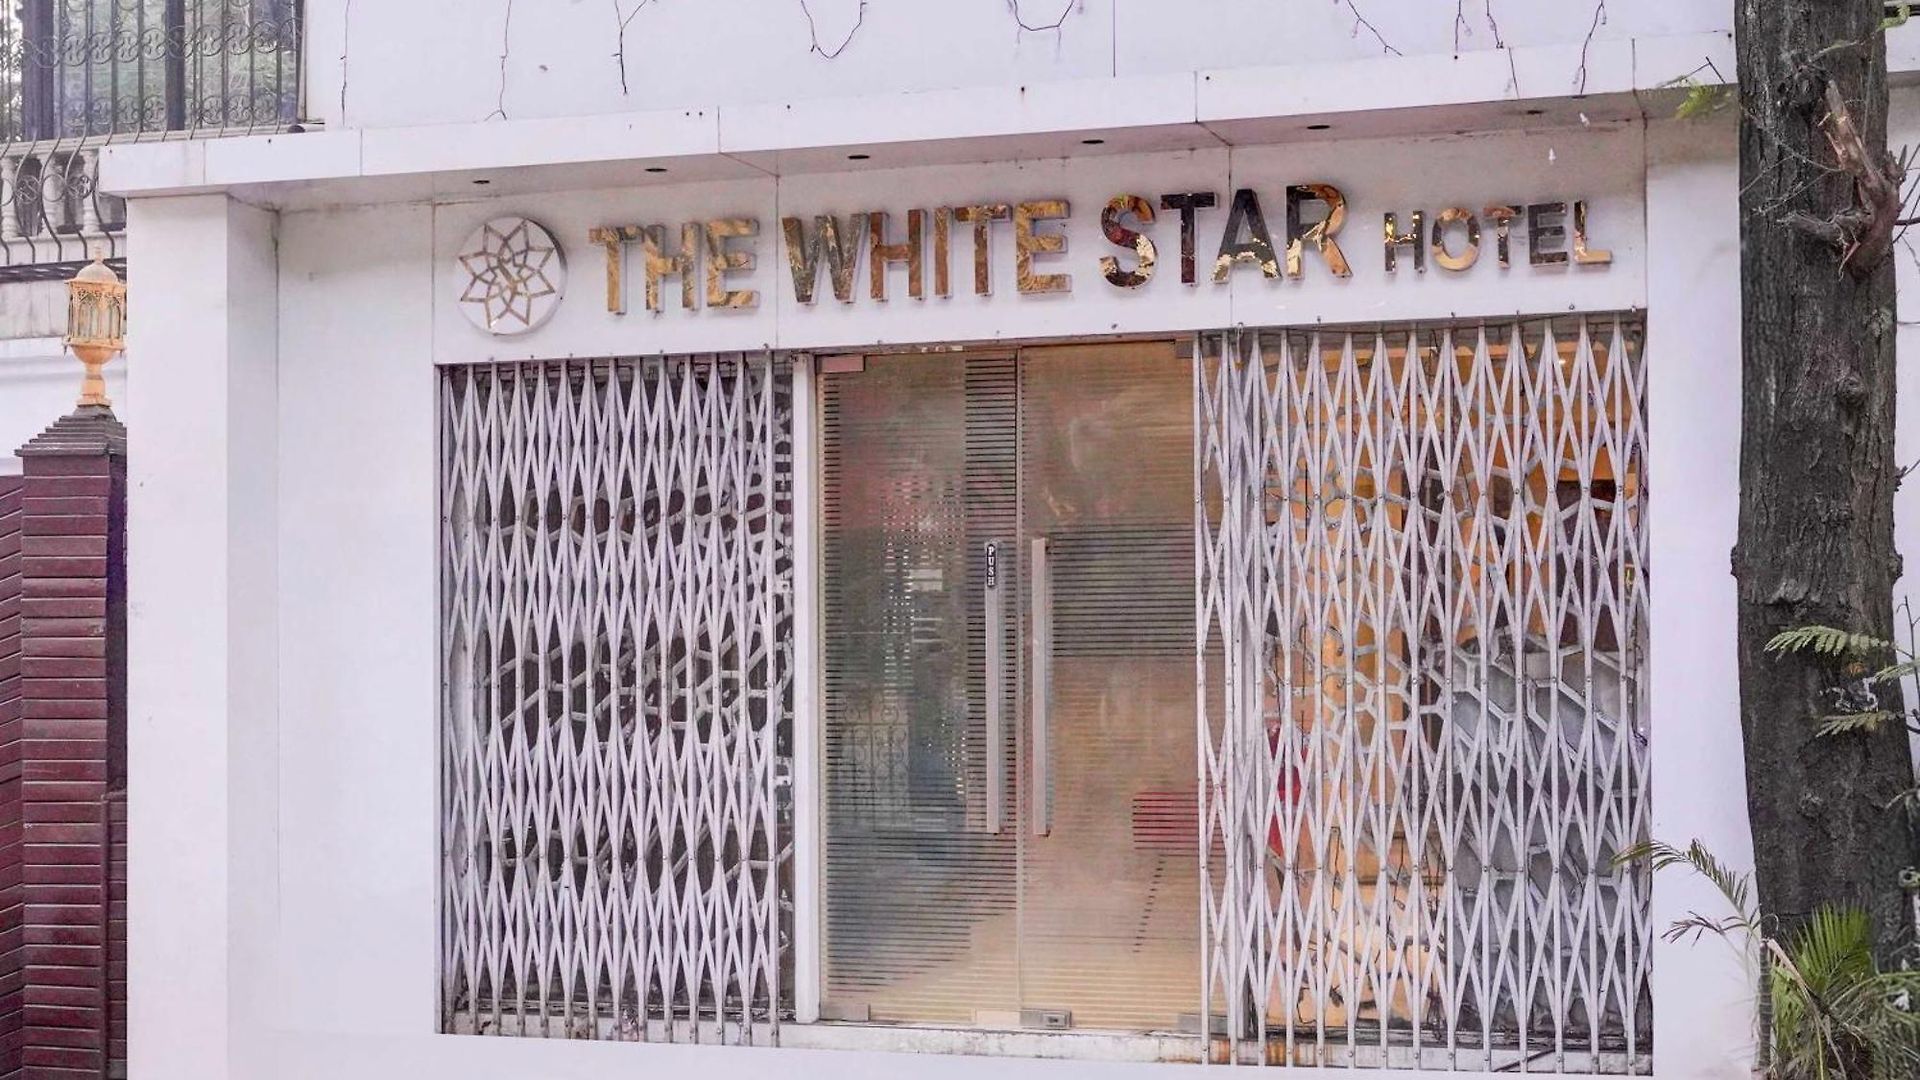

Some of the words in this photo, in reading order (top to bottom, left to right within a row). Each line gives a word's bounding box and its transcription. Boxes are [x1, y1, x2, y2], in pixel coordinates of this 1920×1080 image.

[590, 217, 760, 315] THE
[783, 199, 1071, 304] WHITE
[1100, 183, 1353, 288] STAR
[1384, 200, 1613, 274] HOTEL
[987, 546, 996, 586] PUSH
